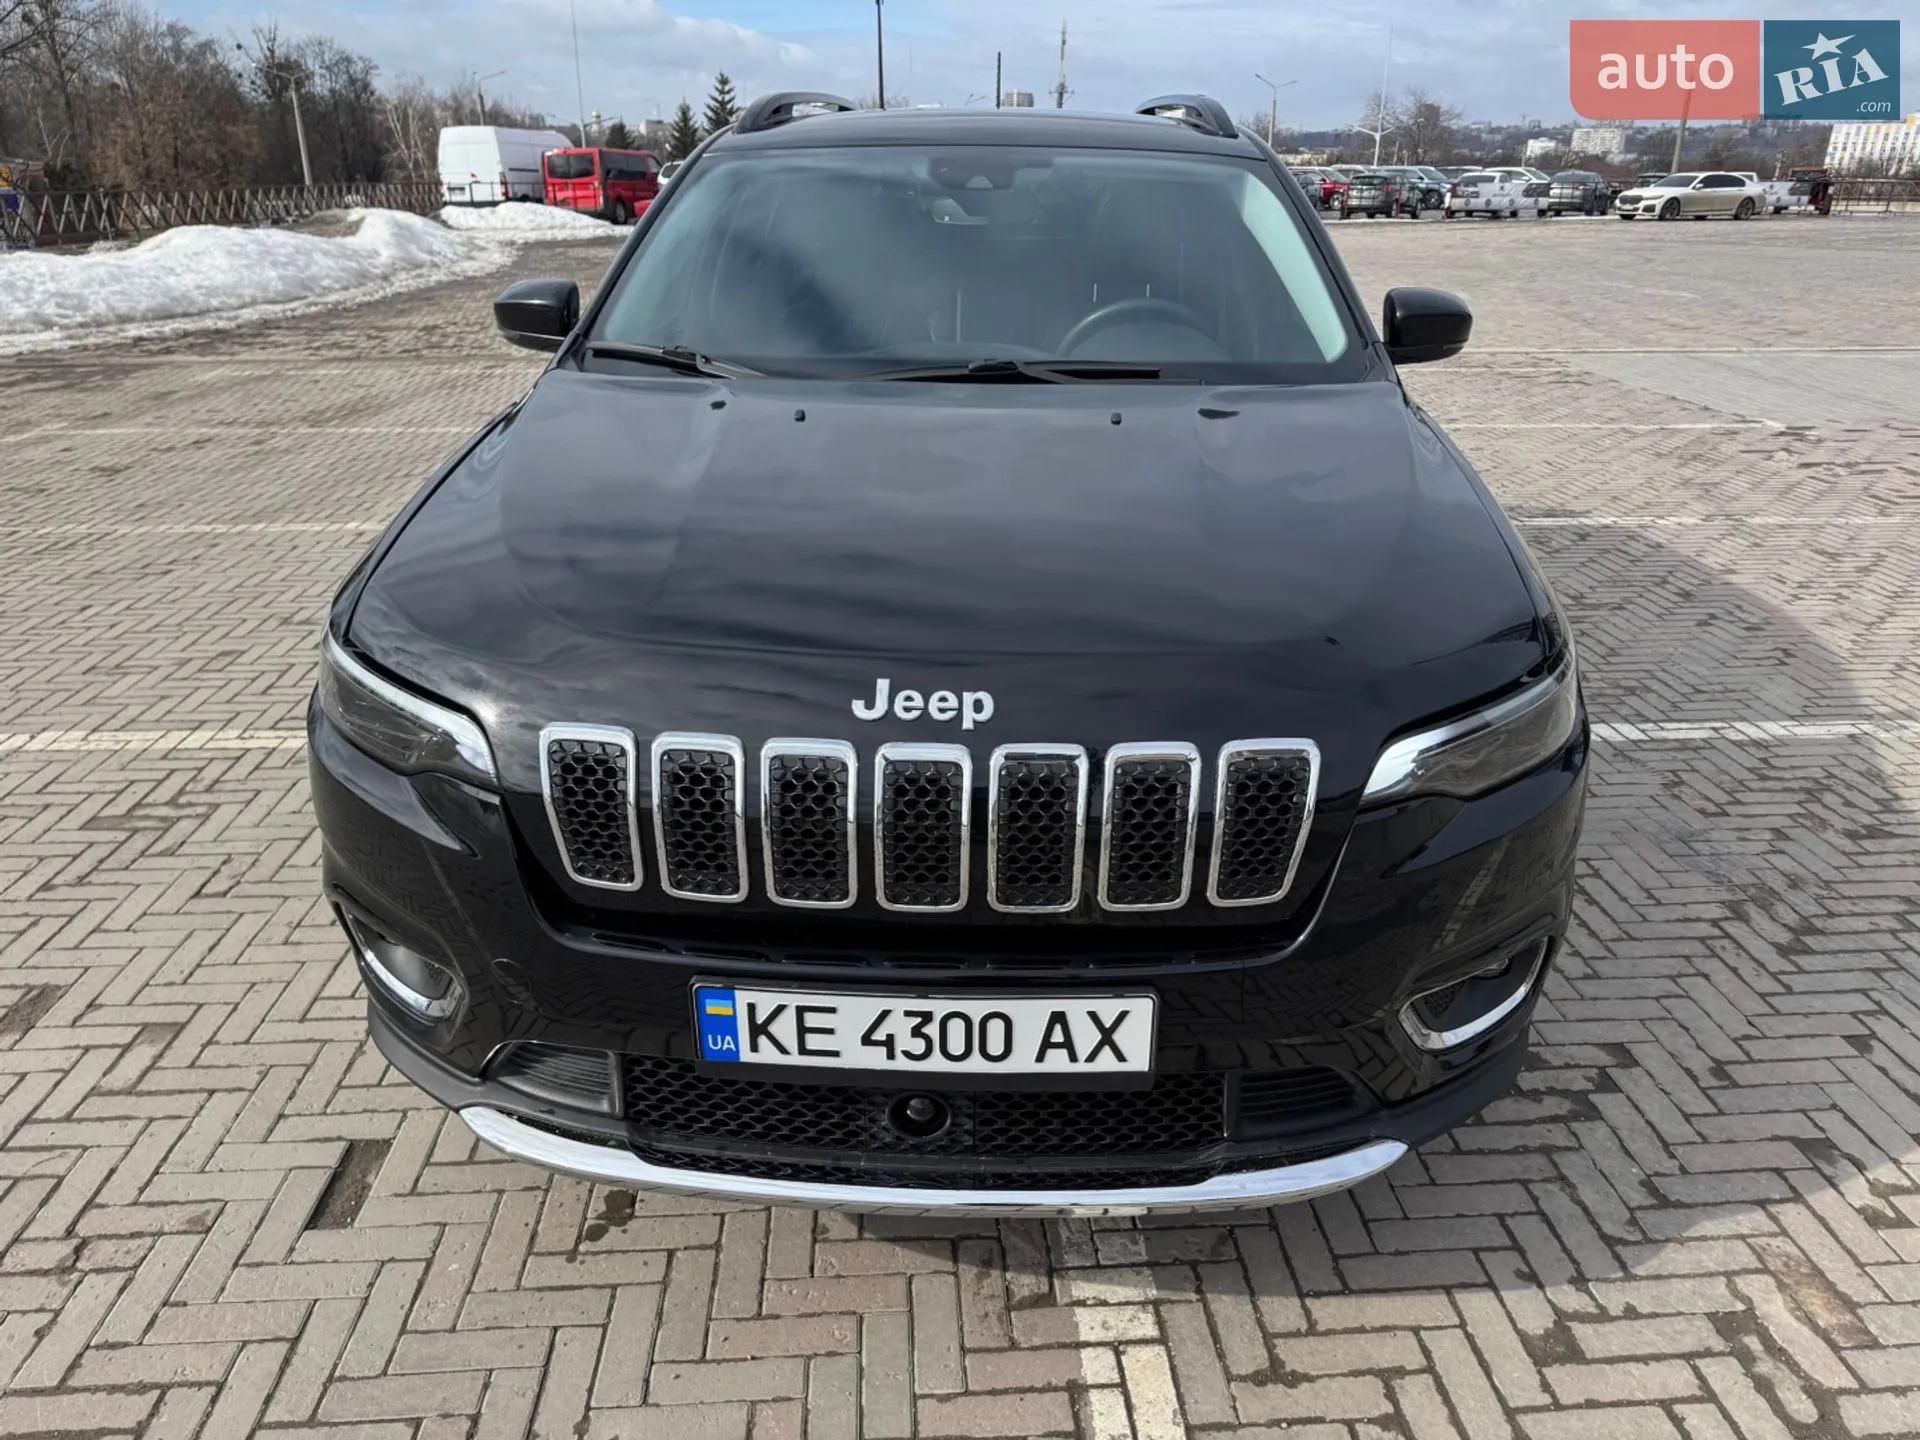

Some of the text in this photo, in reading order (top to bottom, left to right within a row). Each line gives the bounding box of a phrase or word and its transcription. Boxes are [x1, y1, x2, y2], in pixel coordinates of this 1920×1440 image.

[851, 678, 994, 731] Jeep
[708, 1034, 736, 1052] UA
[746, 1001, 1132, 1063] KE 4300 AX
